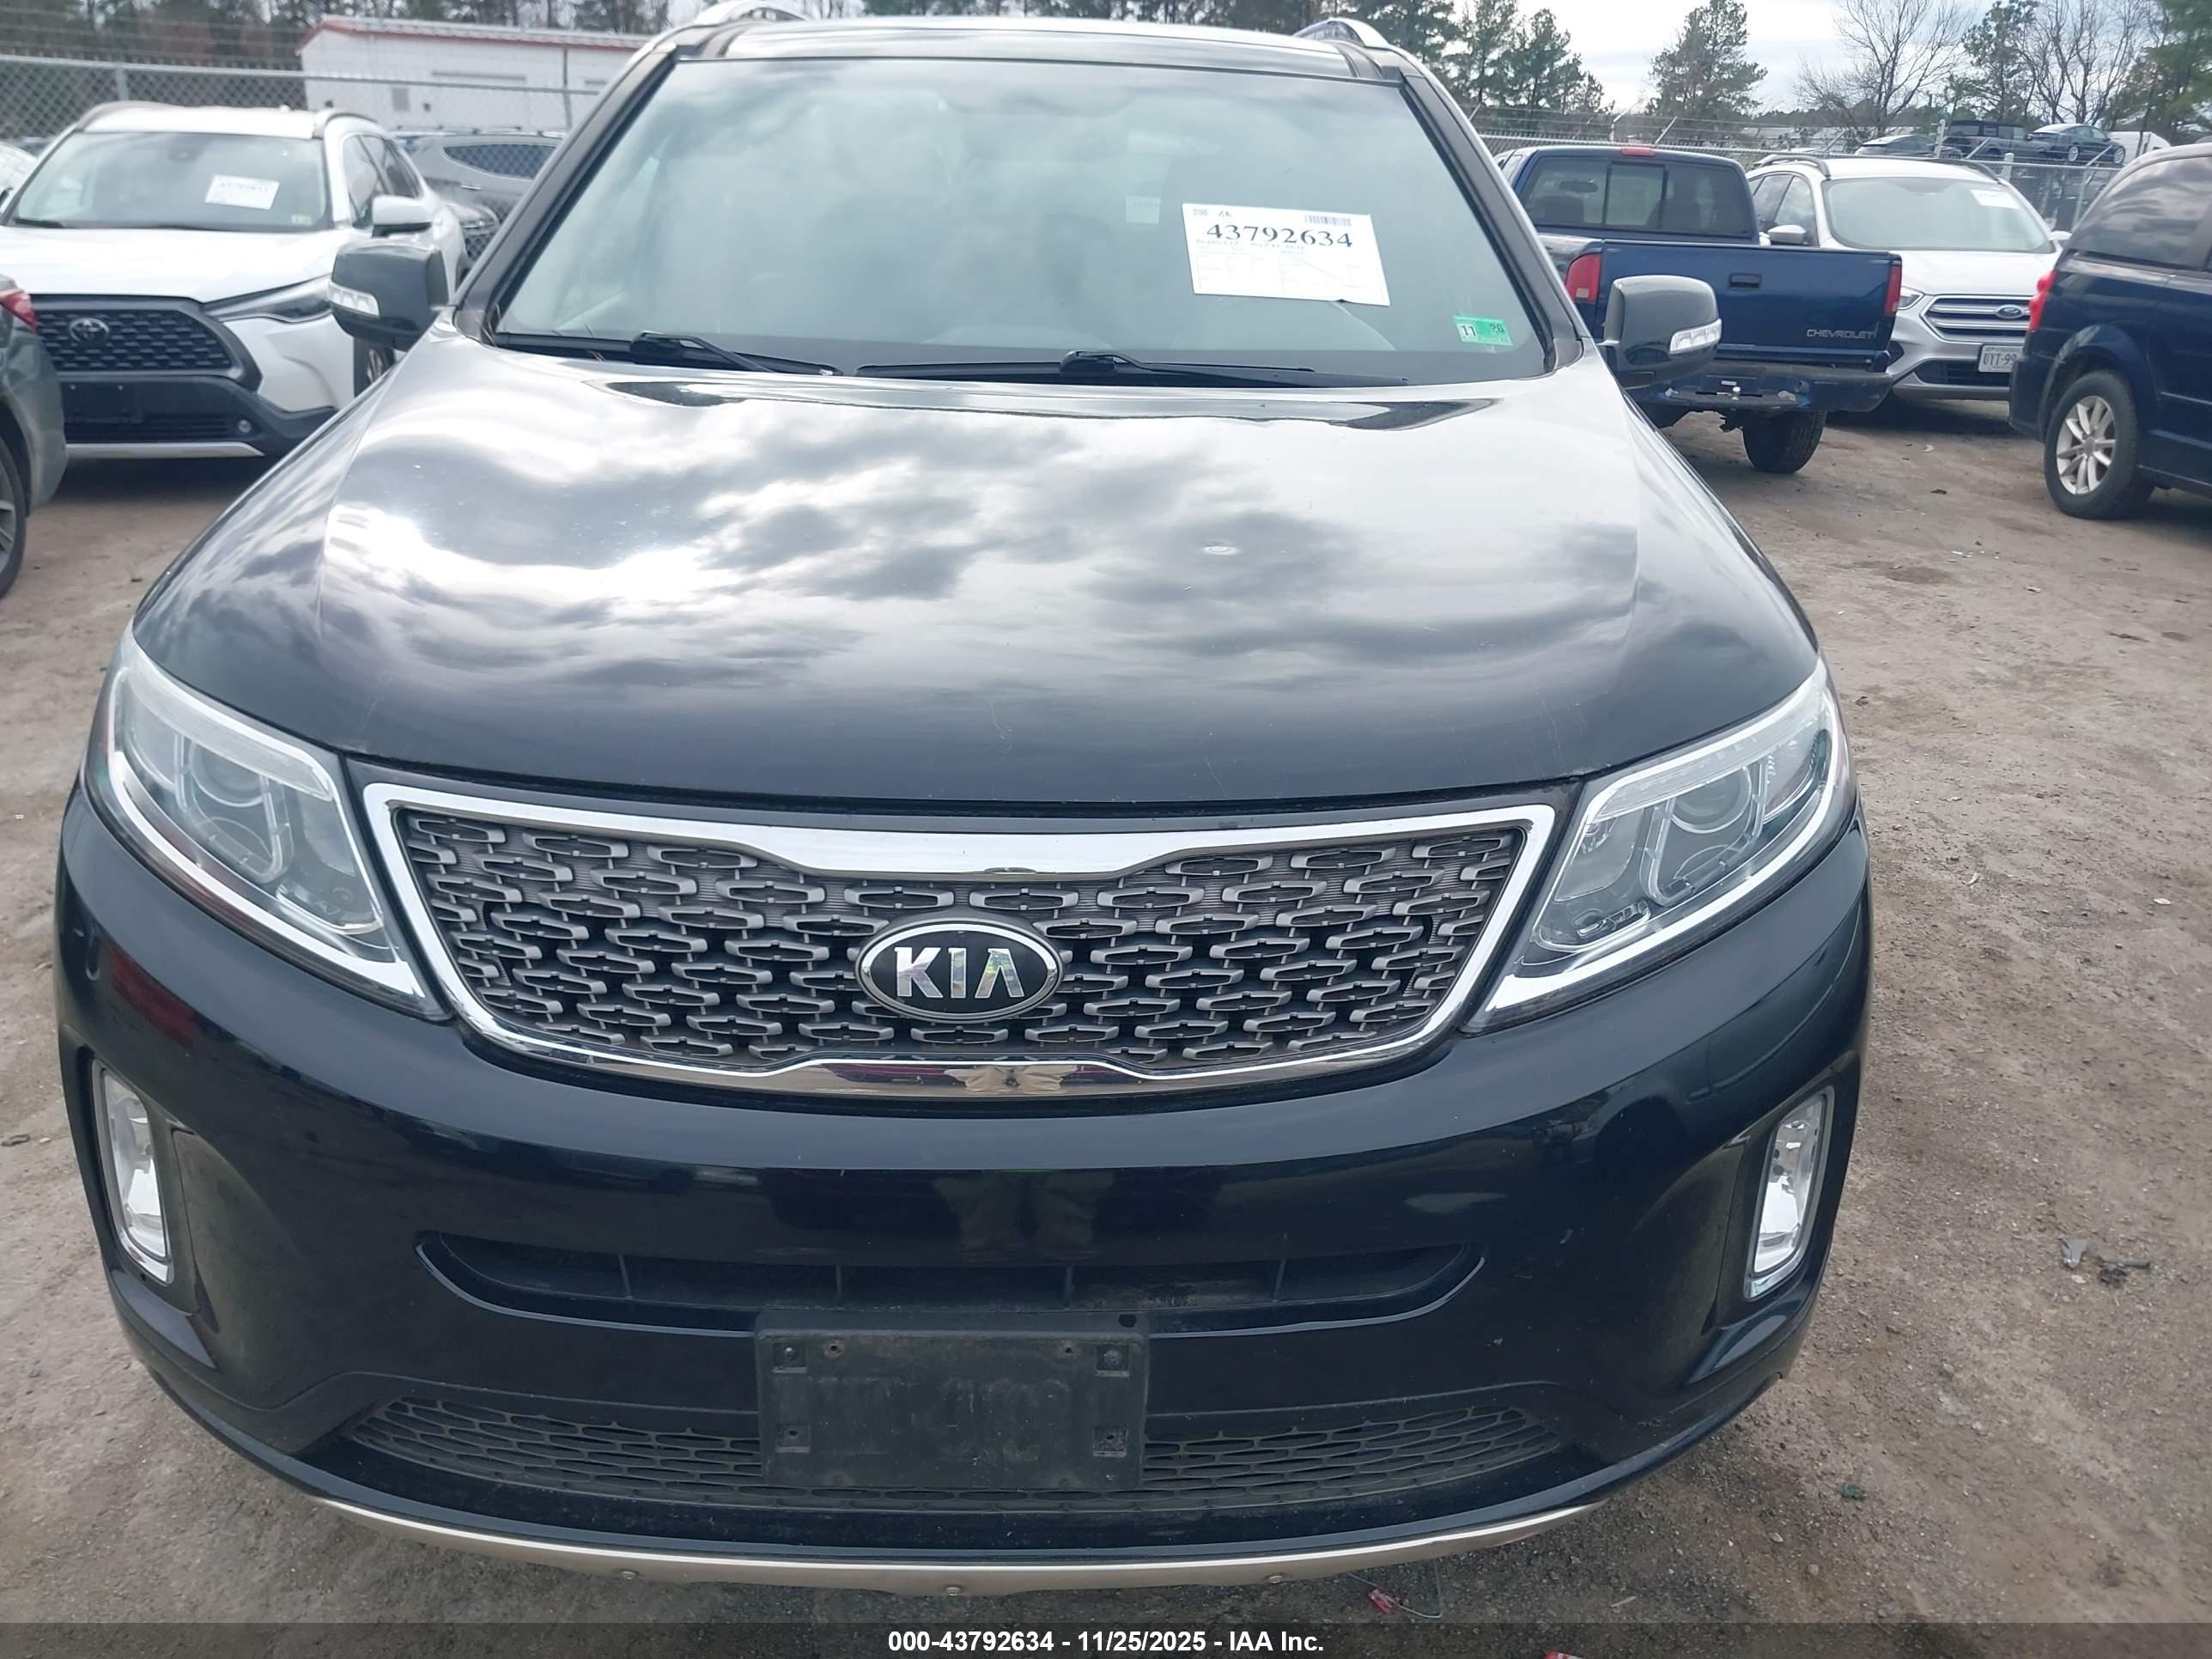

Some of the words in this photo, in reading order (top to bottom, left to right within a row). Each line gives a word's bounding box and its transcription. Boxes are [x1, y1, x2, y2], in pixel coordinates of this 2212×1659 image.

[1206, 223, 1353, 248] 43792634
[1806, 329, 1875, 339] CHEVROLET
[894, 946, 1025, 999] KIA
